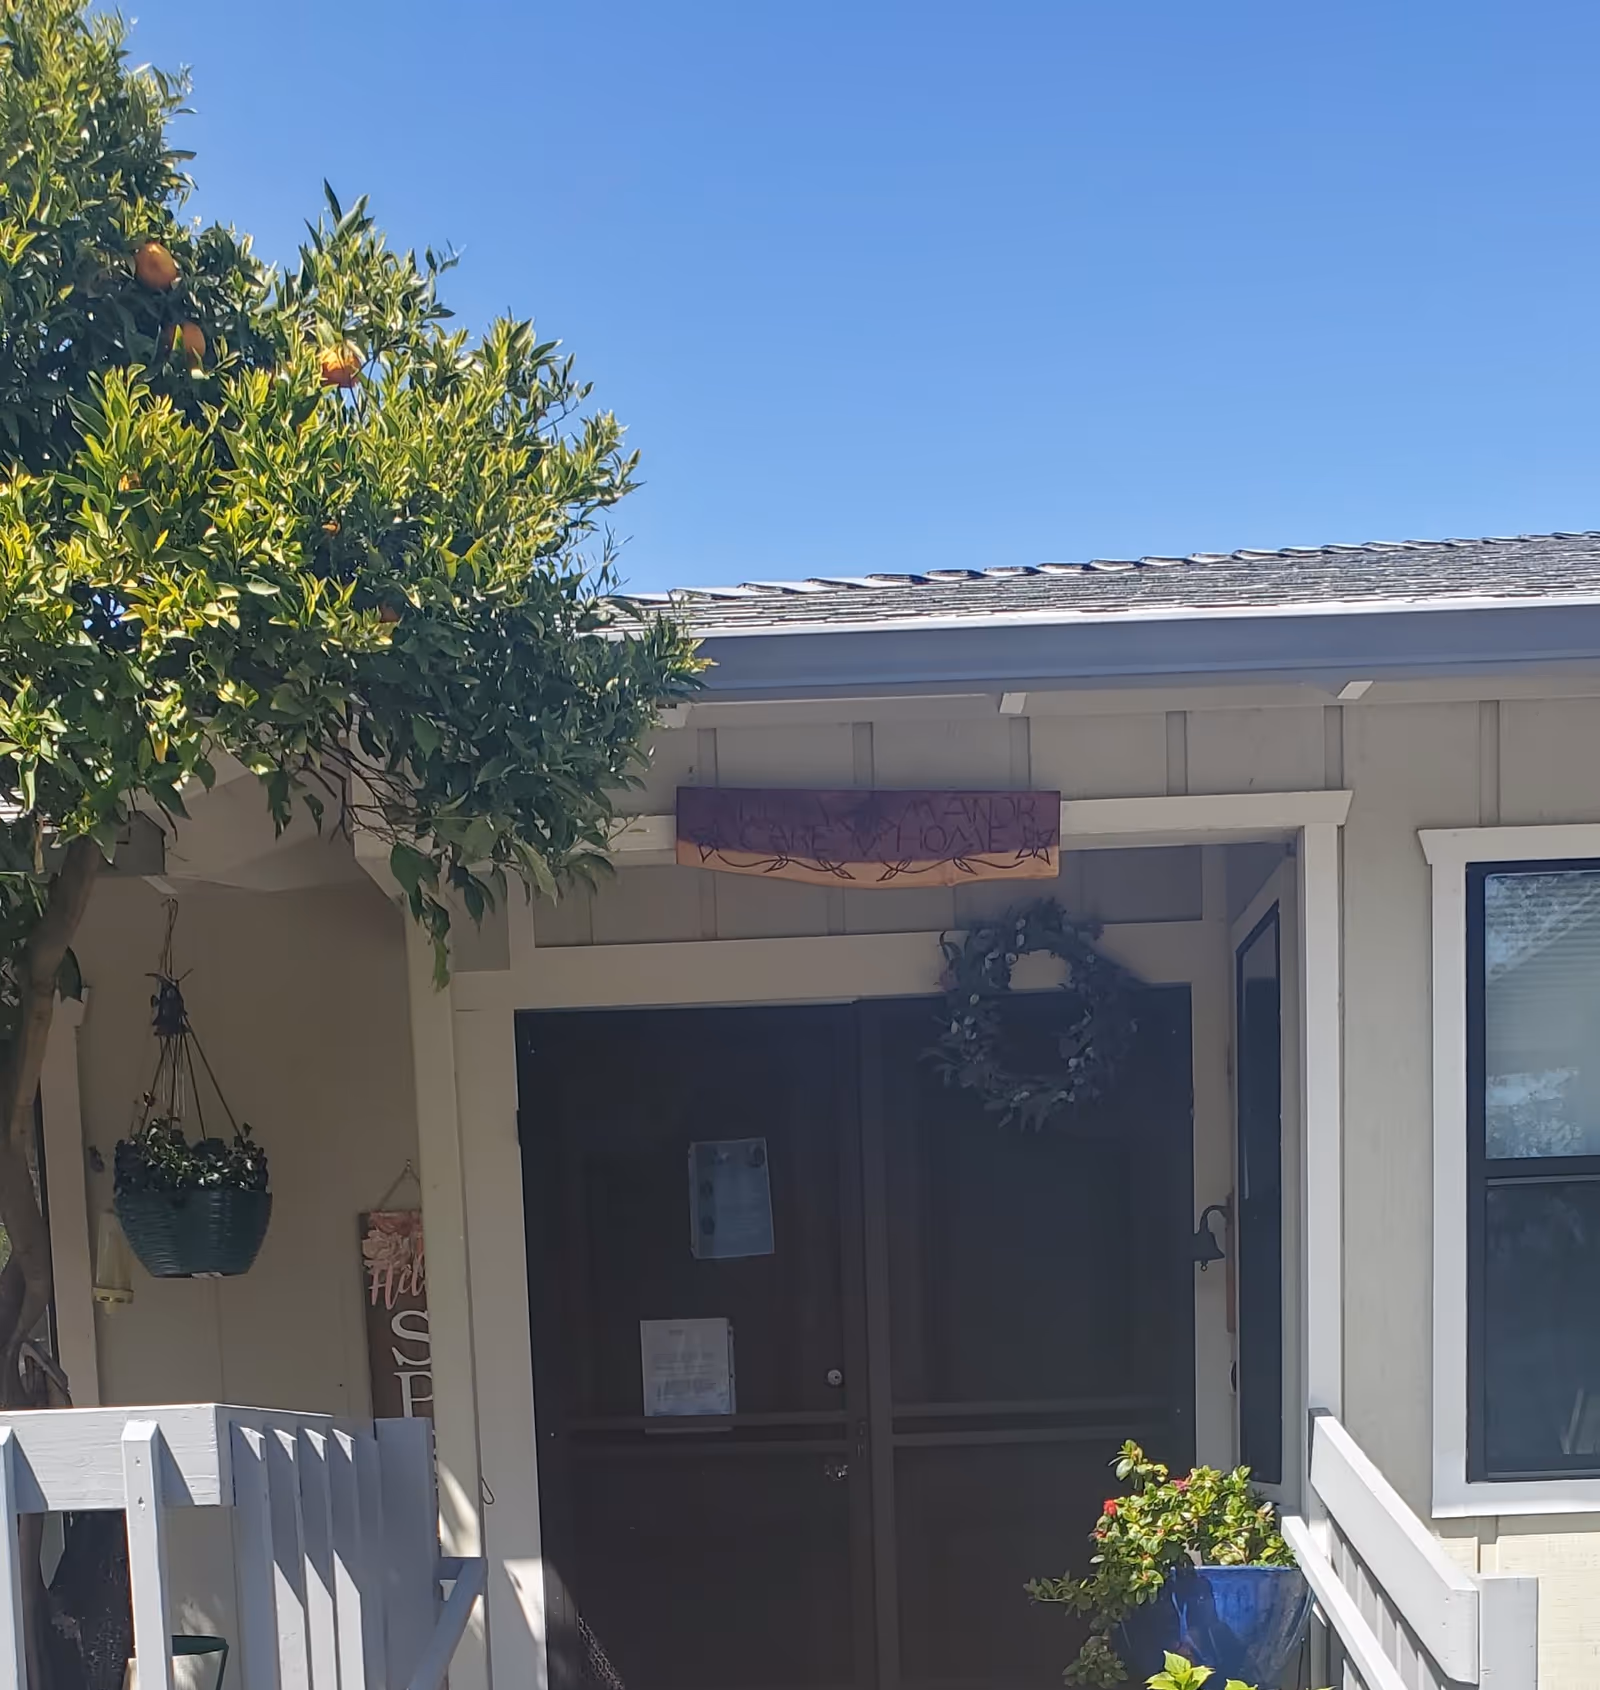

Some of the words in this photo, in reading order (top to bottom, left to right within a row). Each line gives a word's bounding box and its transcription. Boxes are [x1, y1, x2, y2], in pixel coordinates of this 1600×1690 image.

[898, 796, 1037, 826] MANOR
[739, 818, 834, 853] CARE
[896, 823, 1010, 854] HOME
[367, 1259, 427, 1311] Hel
